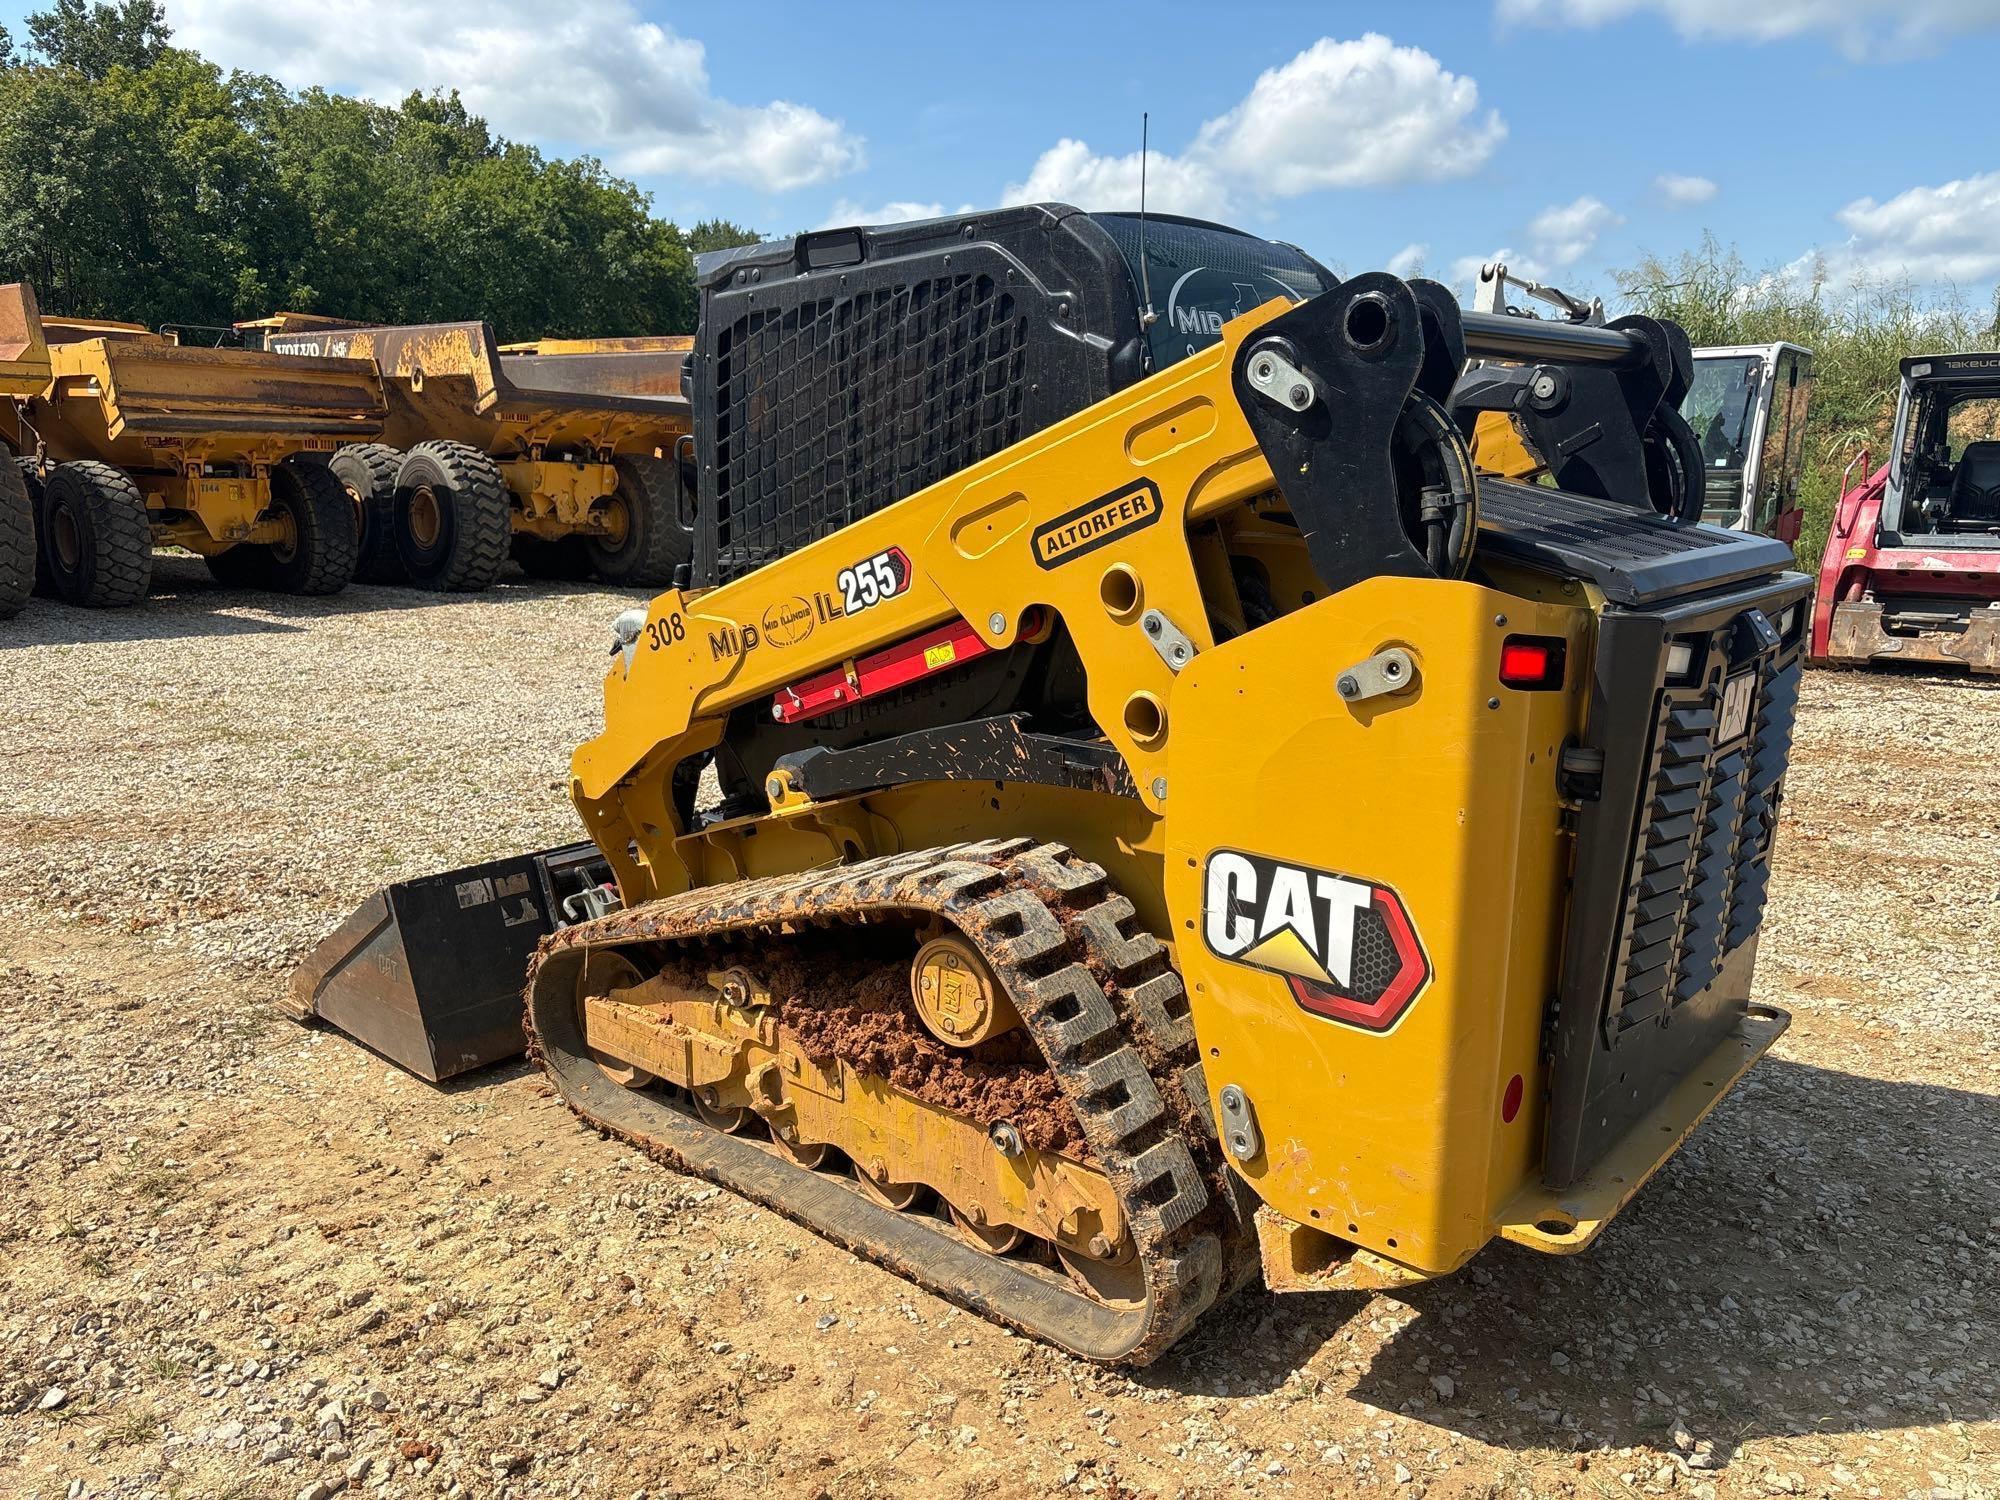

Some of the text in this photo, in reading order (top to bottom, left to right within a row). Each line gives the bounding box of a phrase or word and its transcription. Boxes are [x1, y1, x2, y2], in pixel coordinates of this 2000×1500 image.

[275, 342, 320, 357] VOLVO
[1176, 306, 1225, 335] MID
[1046, 495, 1148, 555] ALTORFER
[838, 552, 897, 613] 255
[646, 612, 685, 651] 308
[707, 624, 760, 662] MID
[813, 592, 845, 625] IL
[764, 607, 811, 632] MID ILLINOIS
[1718, 674, 1756, 743] CAT
[1206, 851, 1372, 990] CAT
